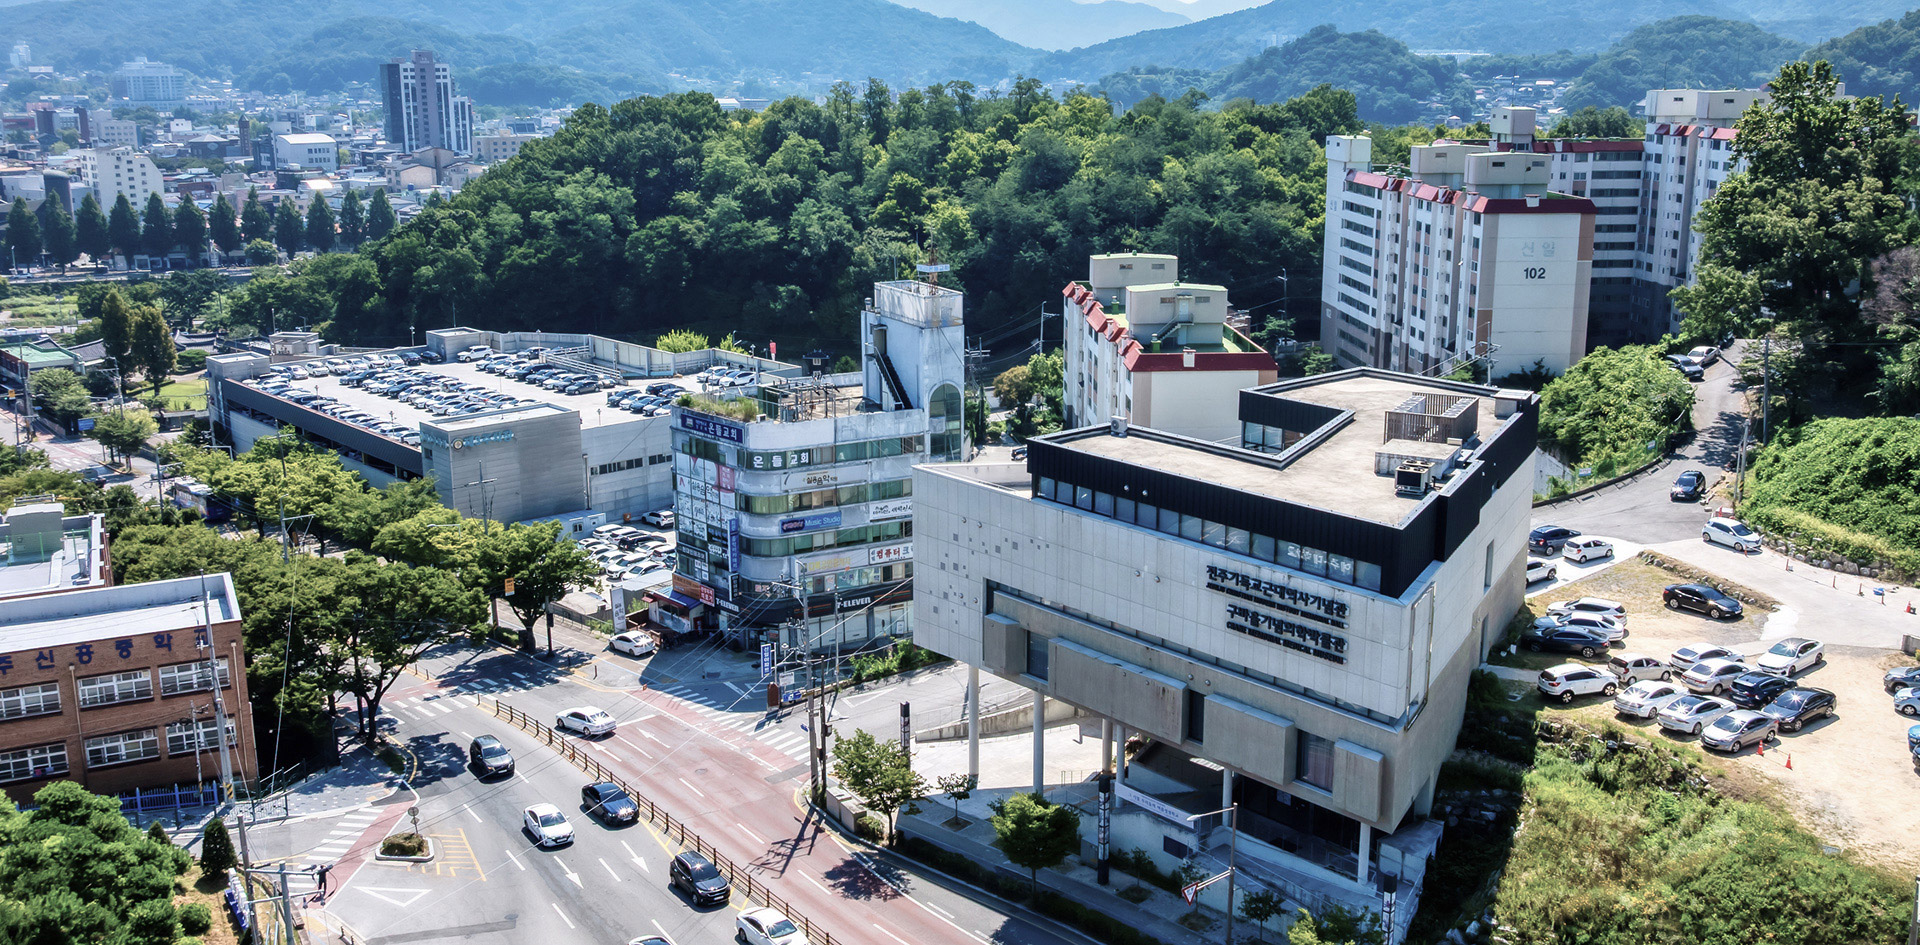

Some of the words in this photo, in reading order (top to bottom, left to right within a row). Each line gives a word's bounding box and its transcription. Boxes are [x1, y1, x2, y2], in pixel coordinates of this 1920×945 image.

[1523, 267, 1546, 280] 102
[708, 422, 737, 441] 온들교회
[805, 519, 822, 527] Music
[823, 516, 841, 525] Studio
[1206, 565, 1348, 619] 전주기독교근대역사기념관
[1226, 603, 1346, 654] 구바울기념의학박물관
[1226, 621, 1248, 634] CRANE
[1247, 627, 1282, 646] MEMORIAL
[1282, 639, 1311, 655] MEDICAL
[1312, 648, 1344, 666] MUSEUM
